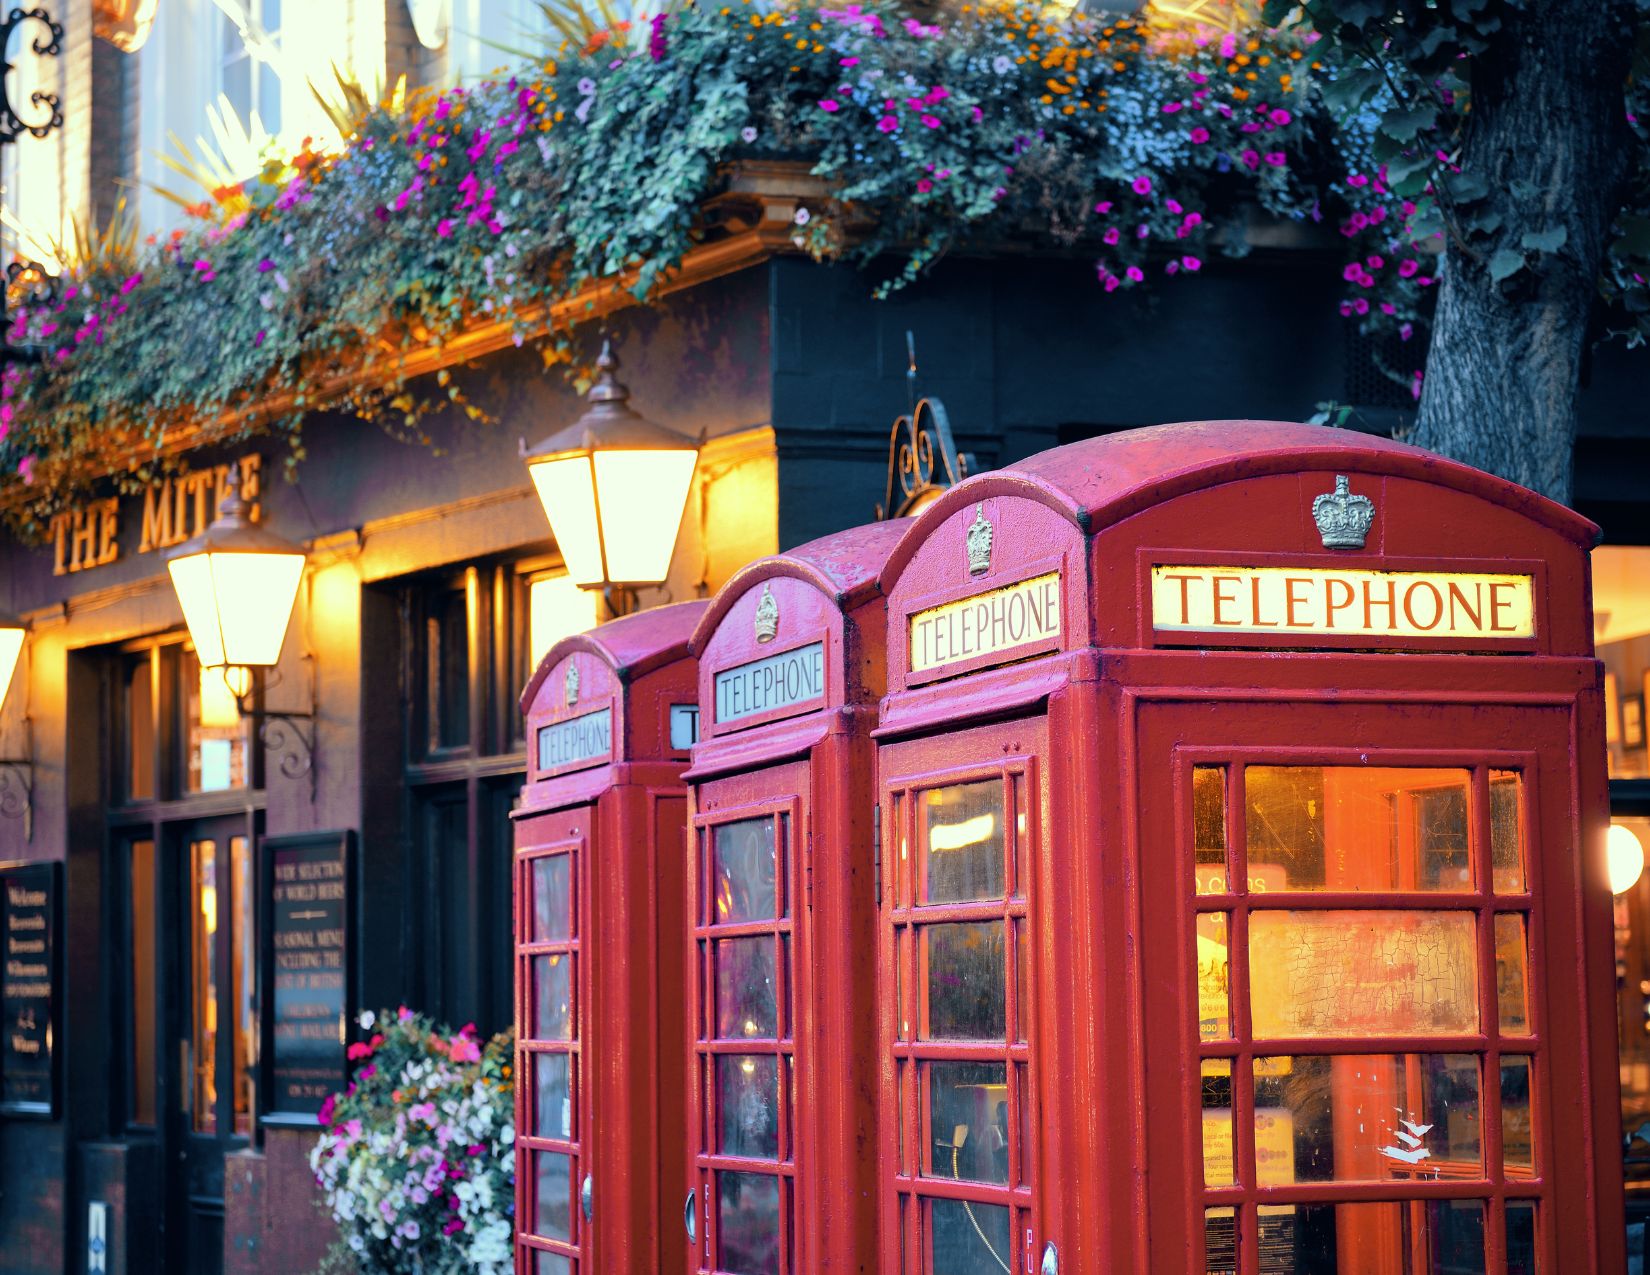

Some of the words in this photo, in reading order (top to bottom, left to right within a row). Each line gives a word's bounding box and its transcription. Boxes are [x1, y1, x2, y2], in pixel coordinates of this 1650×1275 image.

[50, 496, 119, 576] THE
[139, 453, 262, 553] MITRE
[918, 582, 1058, 666] TELEPHONE
[1164, 574, 1517, 632] TELEPHONE
[720, 650, 823, 718] TELEPHONE
[541, 716, 611, 768] TELEPHONE
